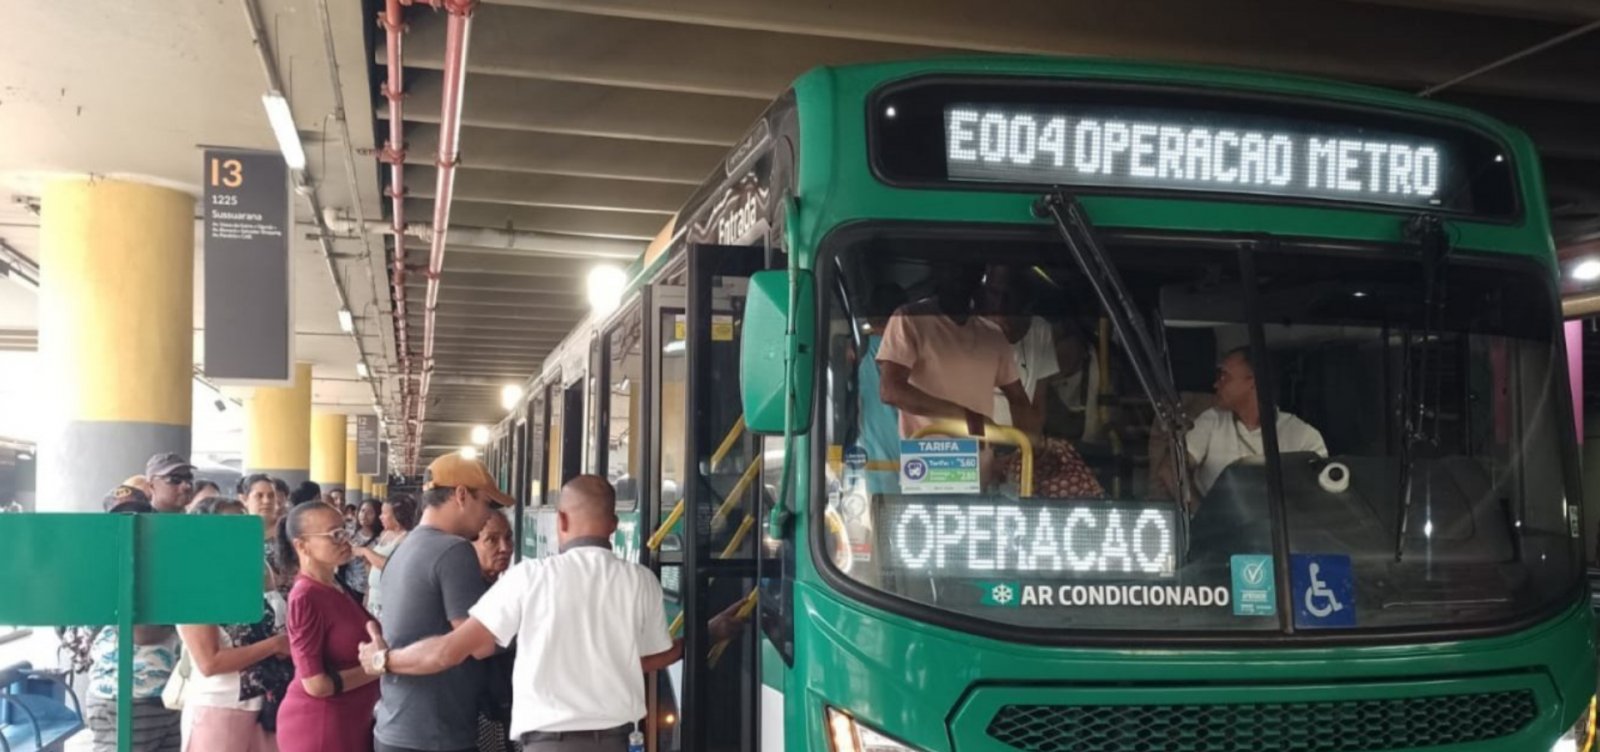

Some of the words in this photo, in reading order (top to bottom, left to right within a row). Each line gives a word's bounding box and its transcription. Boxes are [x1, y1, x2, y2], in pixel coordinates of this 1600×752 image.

[949, 108, 1065, 168] E004
[1074, 119, 1293, 187] OPERACAO
[1307, 136, 1440, 197] METRO
[211, 194, 238, 206] 1225
[211, 209, 263, 221] Sussuarana
[718, 190, 757, 246] Entrada
[918, 441, 960, 452] TARIFA
[897, 503, 1171, 574] OPERACAO
[1020, 584, 1053, 606] AR
[1057, 584, 1230, 607] CONDICIONADO
